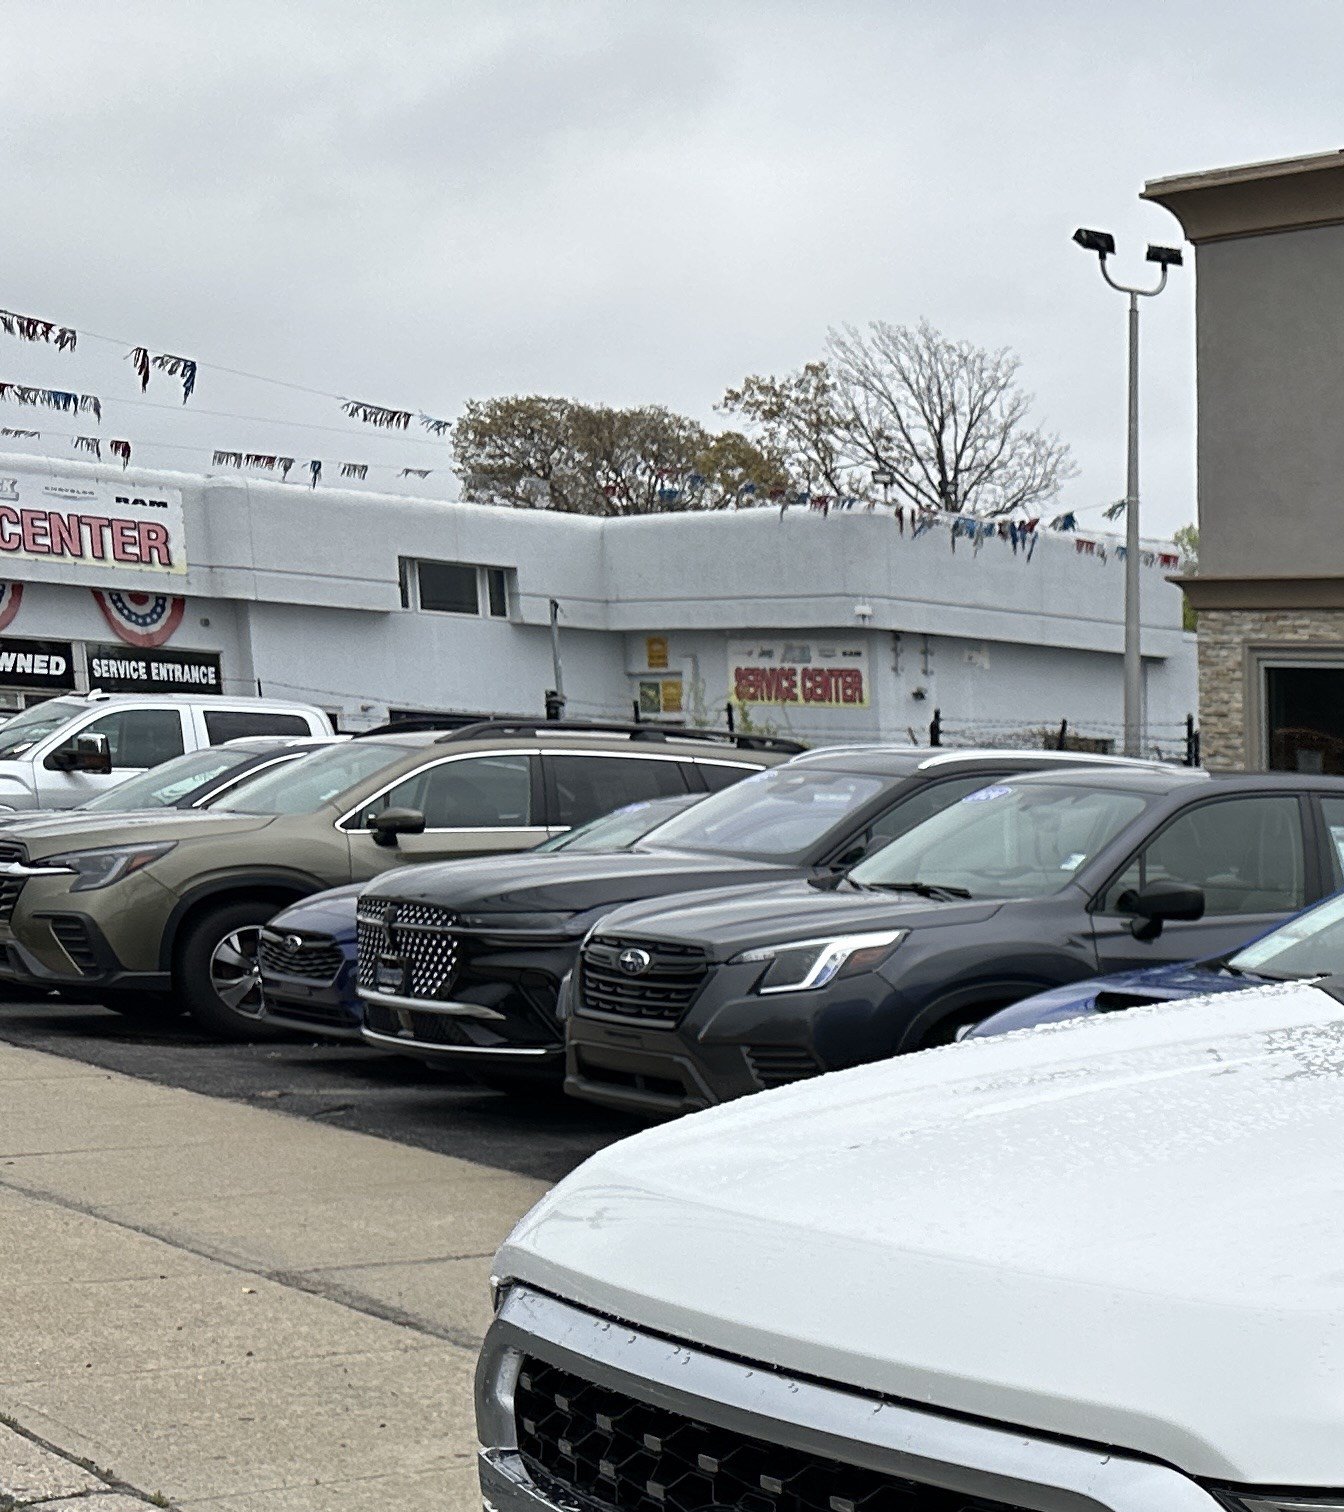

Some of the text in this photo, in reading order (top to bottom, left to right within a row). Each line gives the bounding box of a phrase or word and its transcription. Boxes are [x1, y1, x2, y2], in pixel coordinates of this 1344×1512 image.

[115, 496, 168, 508] RAM
[0, 505, 172, 566] CENTER
[92, 658, 216, 685] SERVICE ENTRANCE
[734, 666, 864, 704] SERVICE CENTER
